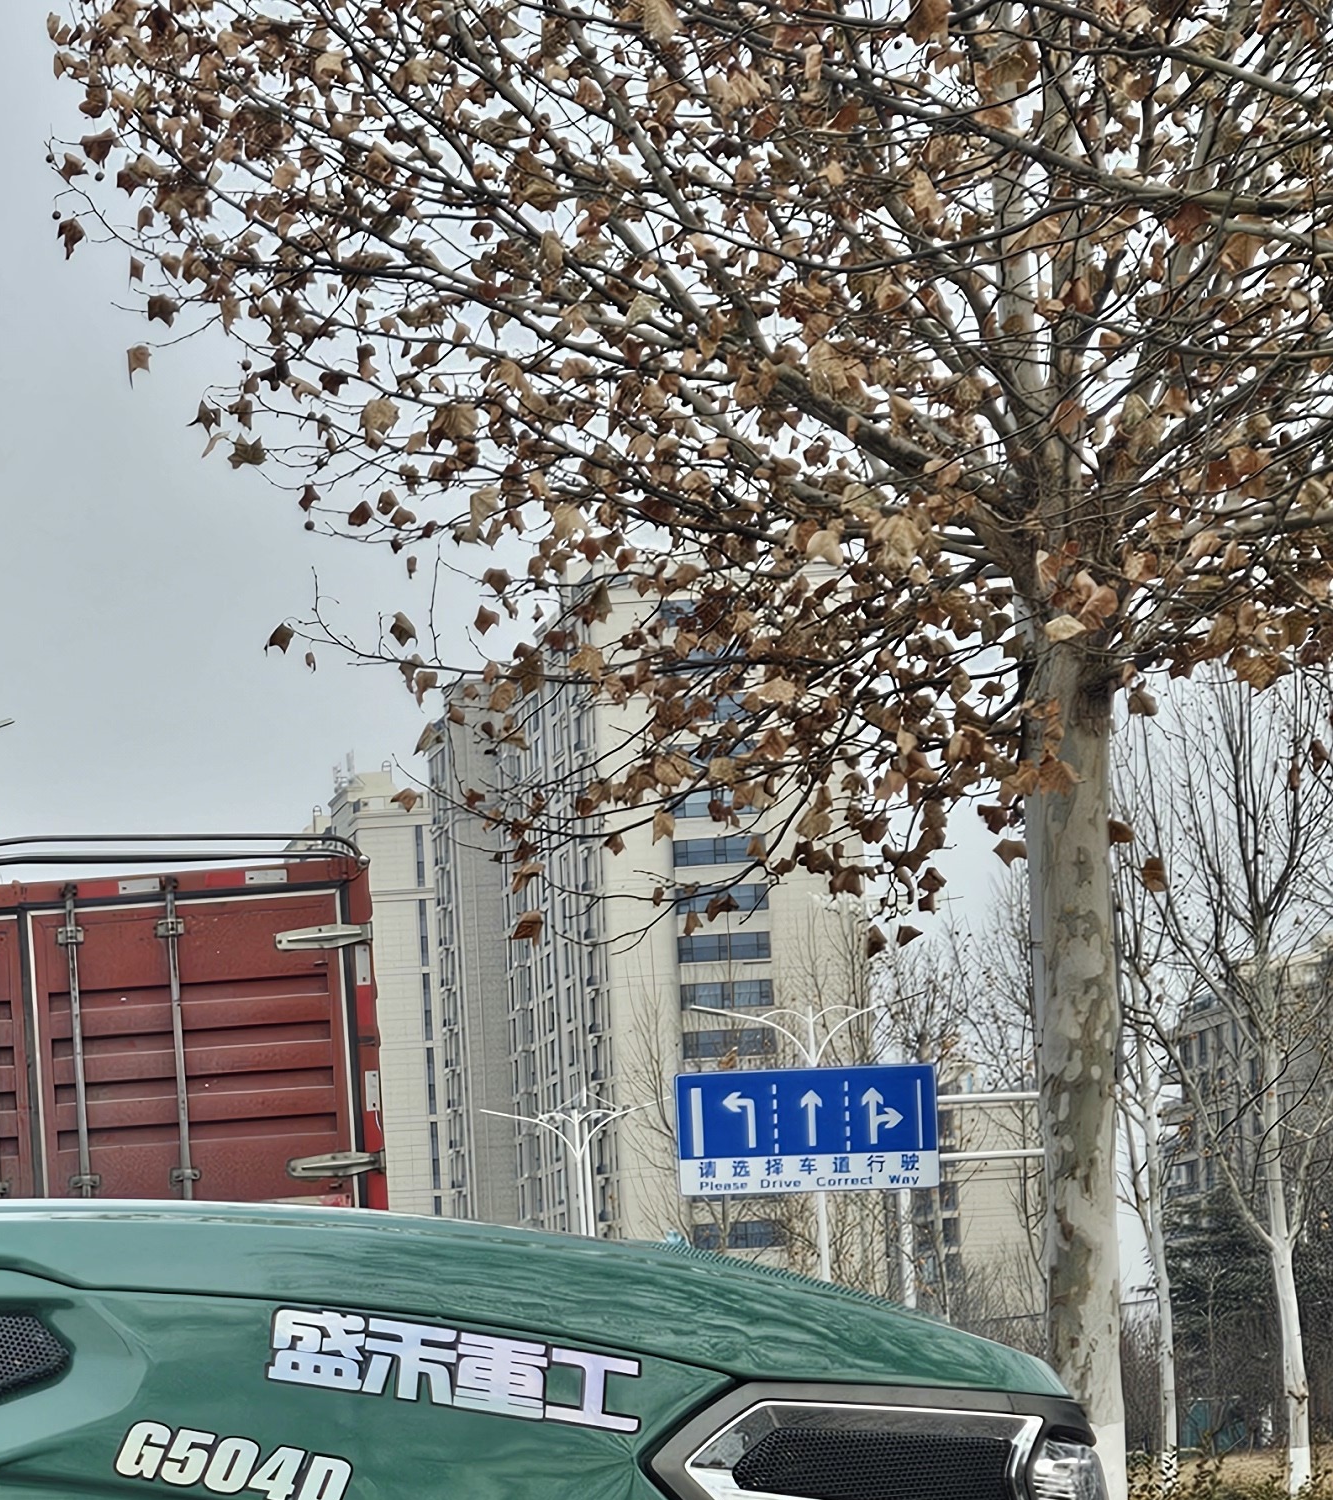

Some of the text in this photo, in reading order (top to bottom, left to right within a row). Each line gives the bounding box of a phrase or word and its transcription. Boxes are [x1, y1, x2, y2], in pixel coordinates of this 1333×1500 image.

[699, 1153, 919, 1178] 请选择车道行驶
[700, 1174, 919, 1191] Please Drive Correct Way
[267, 1308, 640, 1433] 盛禾重工
